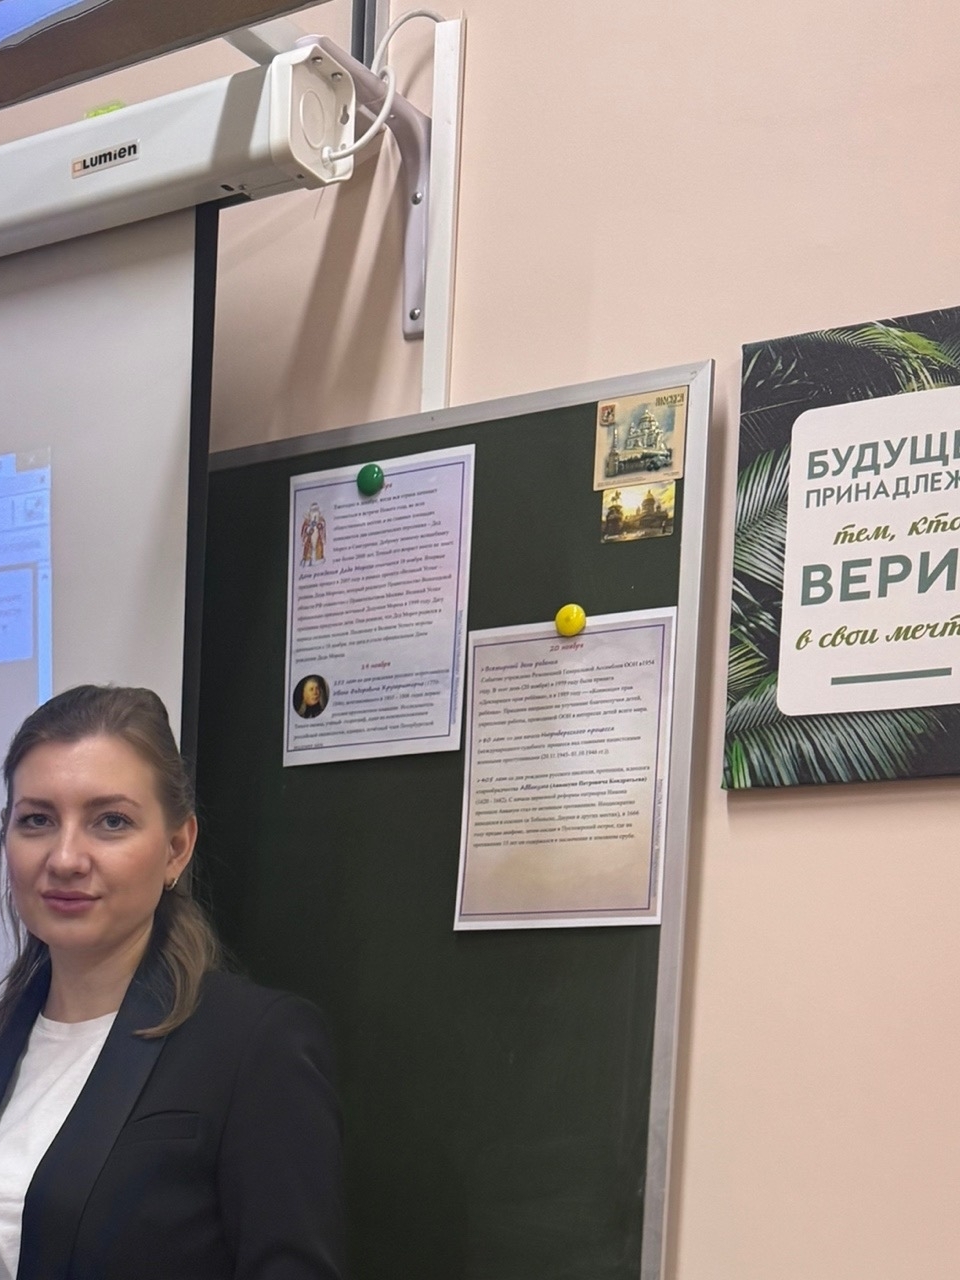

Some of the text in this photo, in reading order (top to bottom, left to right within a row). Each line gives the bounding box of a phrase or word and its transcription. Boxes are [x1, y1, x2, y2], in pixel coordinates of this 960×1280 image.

[807, 430, 960, 480] БУДУЩ
[833, 512, 960, 545] тем, кто
[800, 547, 959, 606] ВЕРИ
[795, 629, 813, 650] в
[818, 624, 879, 648] свои
